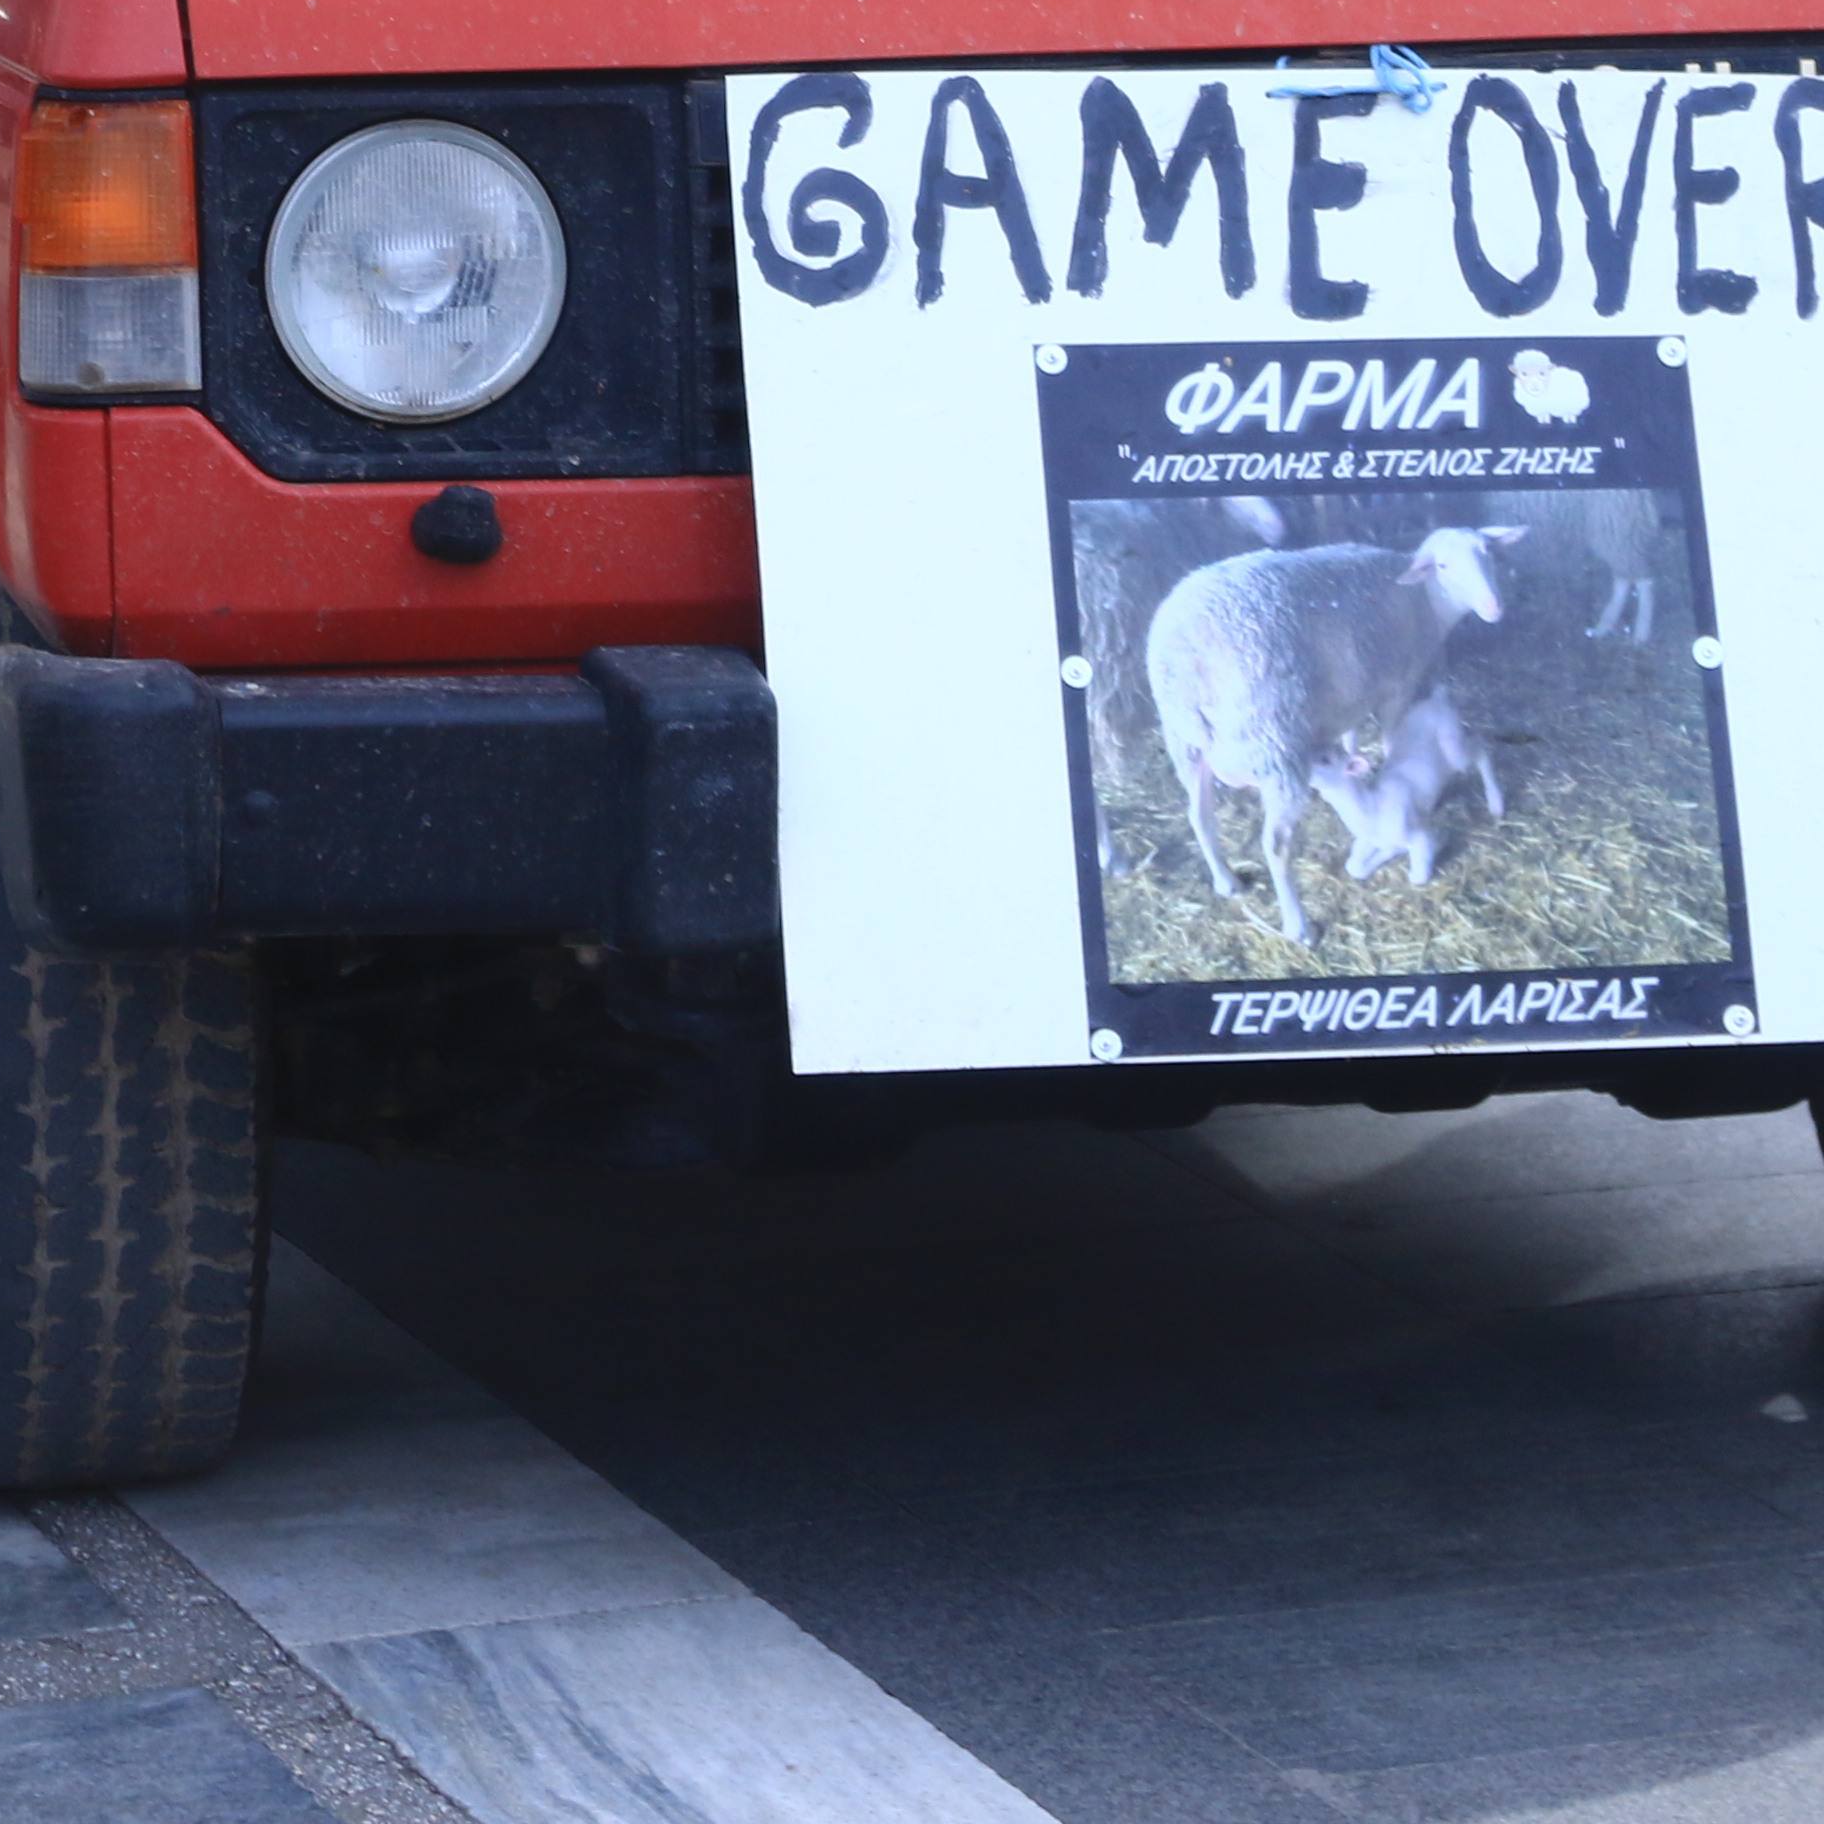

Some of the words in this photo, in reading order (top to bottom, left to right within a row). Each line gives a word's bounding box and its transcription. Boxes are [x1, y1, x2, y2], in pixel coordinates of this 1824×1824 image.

[742, 71, 1382, 322] GAME
[1164, 357, 1481, 435] ΦΑΡΜΑ
[1332, 450, 1356, 479] &
[1357, 448, 1494, 478] ΣΤΕΛΙΟΣ
[1209, 985, 1438, 1036] ΤΕΡΨΙΘΕΑ
[1446, 977, 1661, 1028] ΛΑΡΙΣΑΣ
